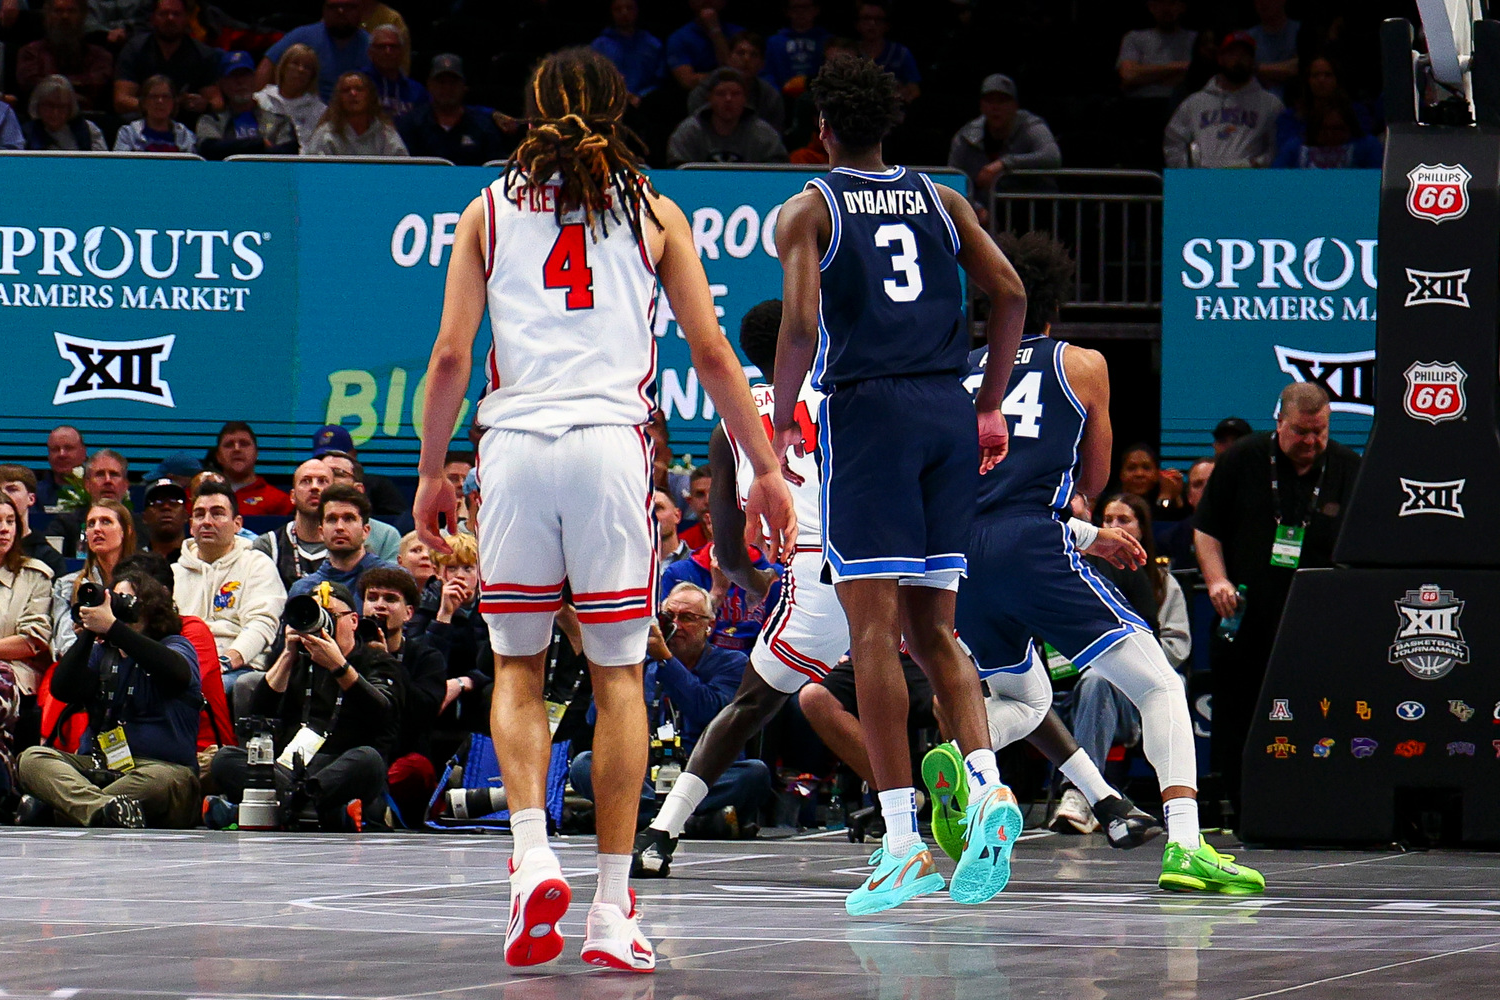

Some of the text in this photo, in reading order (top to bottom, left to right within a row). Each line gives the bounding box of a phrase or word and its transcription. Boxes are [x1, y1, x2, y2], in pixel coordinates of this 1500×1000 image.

[1417, 172, 1462, 183] PHILLIPS
[842, 189, 929, 215] DYBANTSA
[1418, 186, 1458, 210] 66
[543, 222, 595, 311] 4
[873, 221, 925, 304] 3
[120, 285, 251, 312] MARKET
[1194, 295, 1335, 322] FARMERS
[1413, 370, 1458, 382] PHILLIPS
[1415, 386, 1455, 410] 66
[1422, 591, 1438, 601] 66
[1399, 605, 1460, 639] XII
[1393, 645, 1465, 659] TOURNAMENT
[1395, 639, 1463, 652] BASKETBALL
